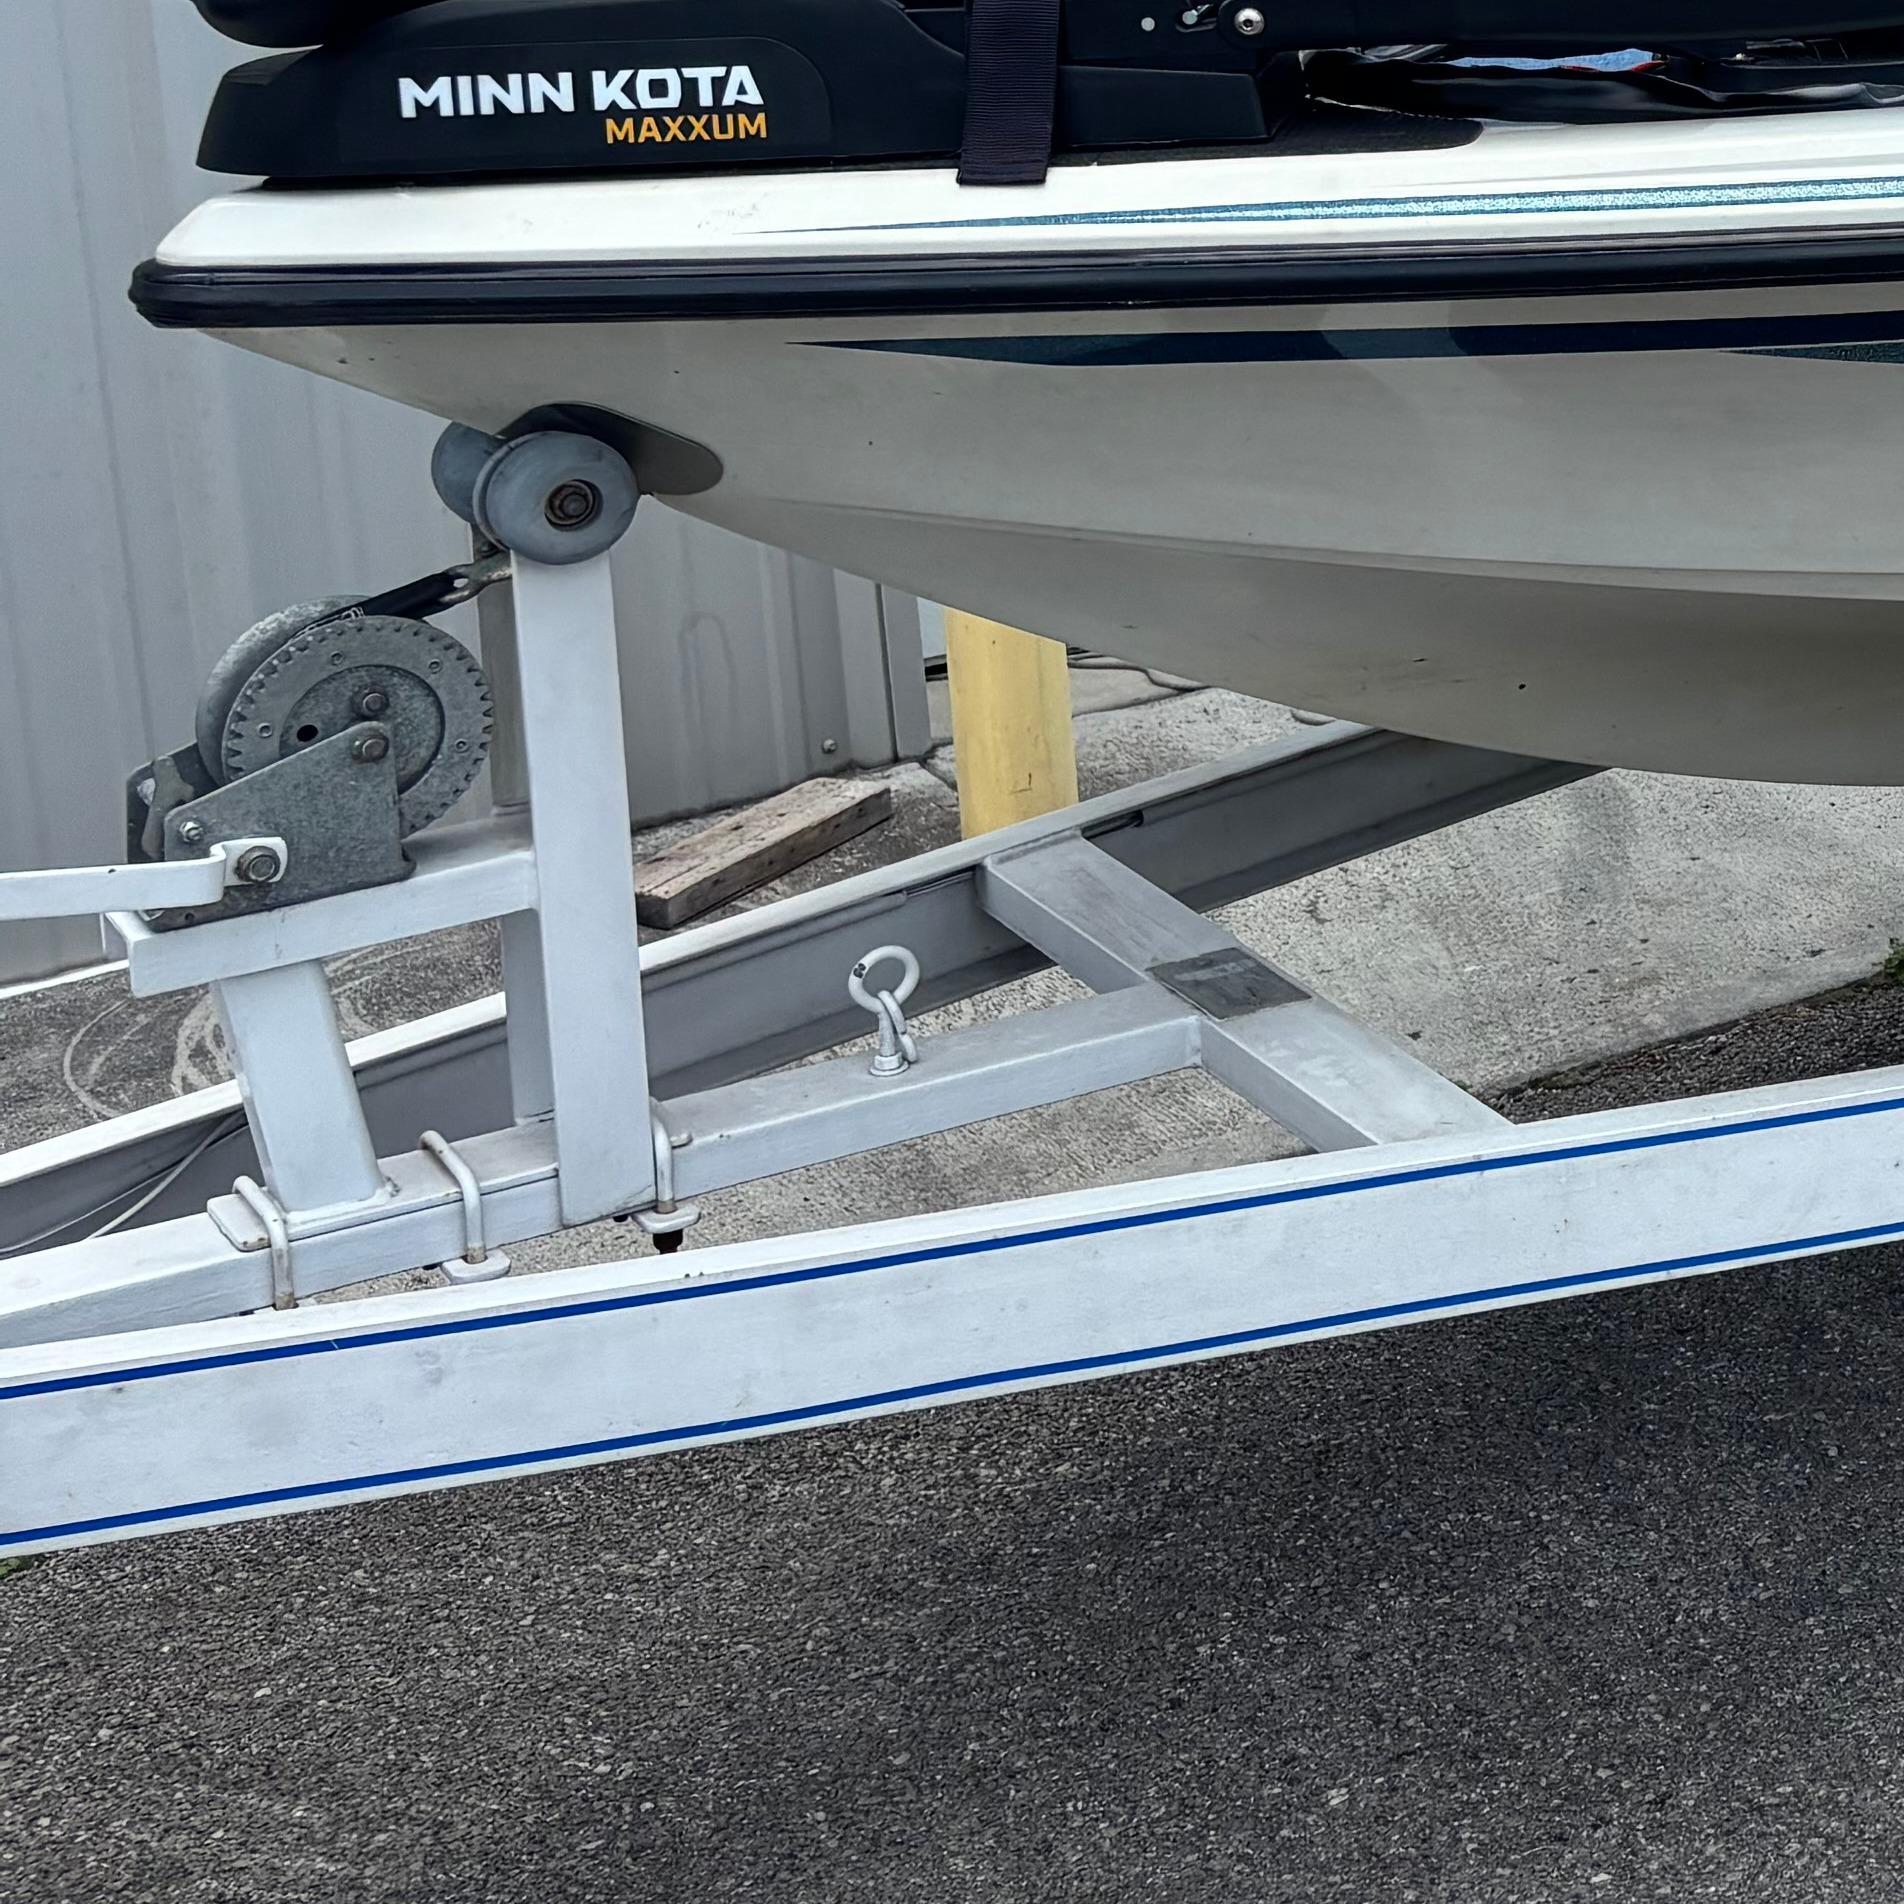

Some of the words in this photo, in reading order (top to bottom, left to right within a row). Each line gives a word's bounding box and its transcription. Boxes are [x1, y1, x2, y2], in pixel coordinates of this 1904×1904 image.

[398, 71, 575, 119] MINN
[592, 65, 764, 111] KOTA
[604, 111, 768, 144] MAXXUM
